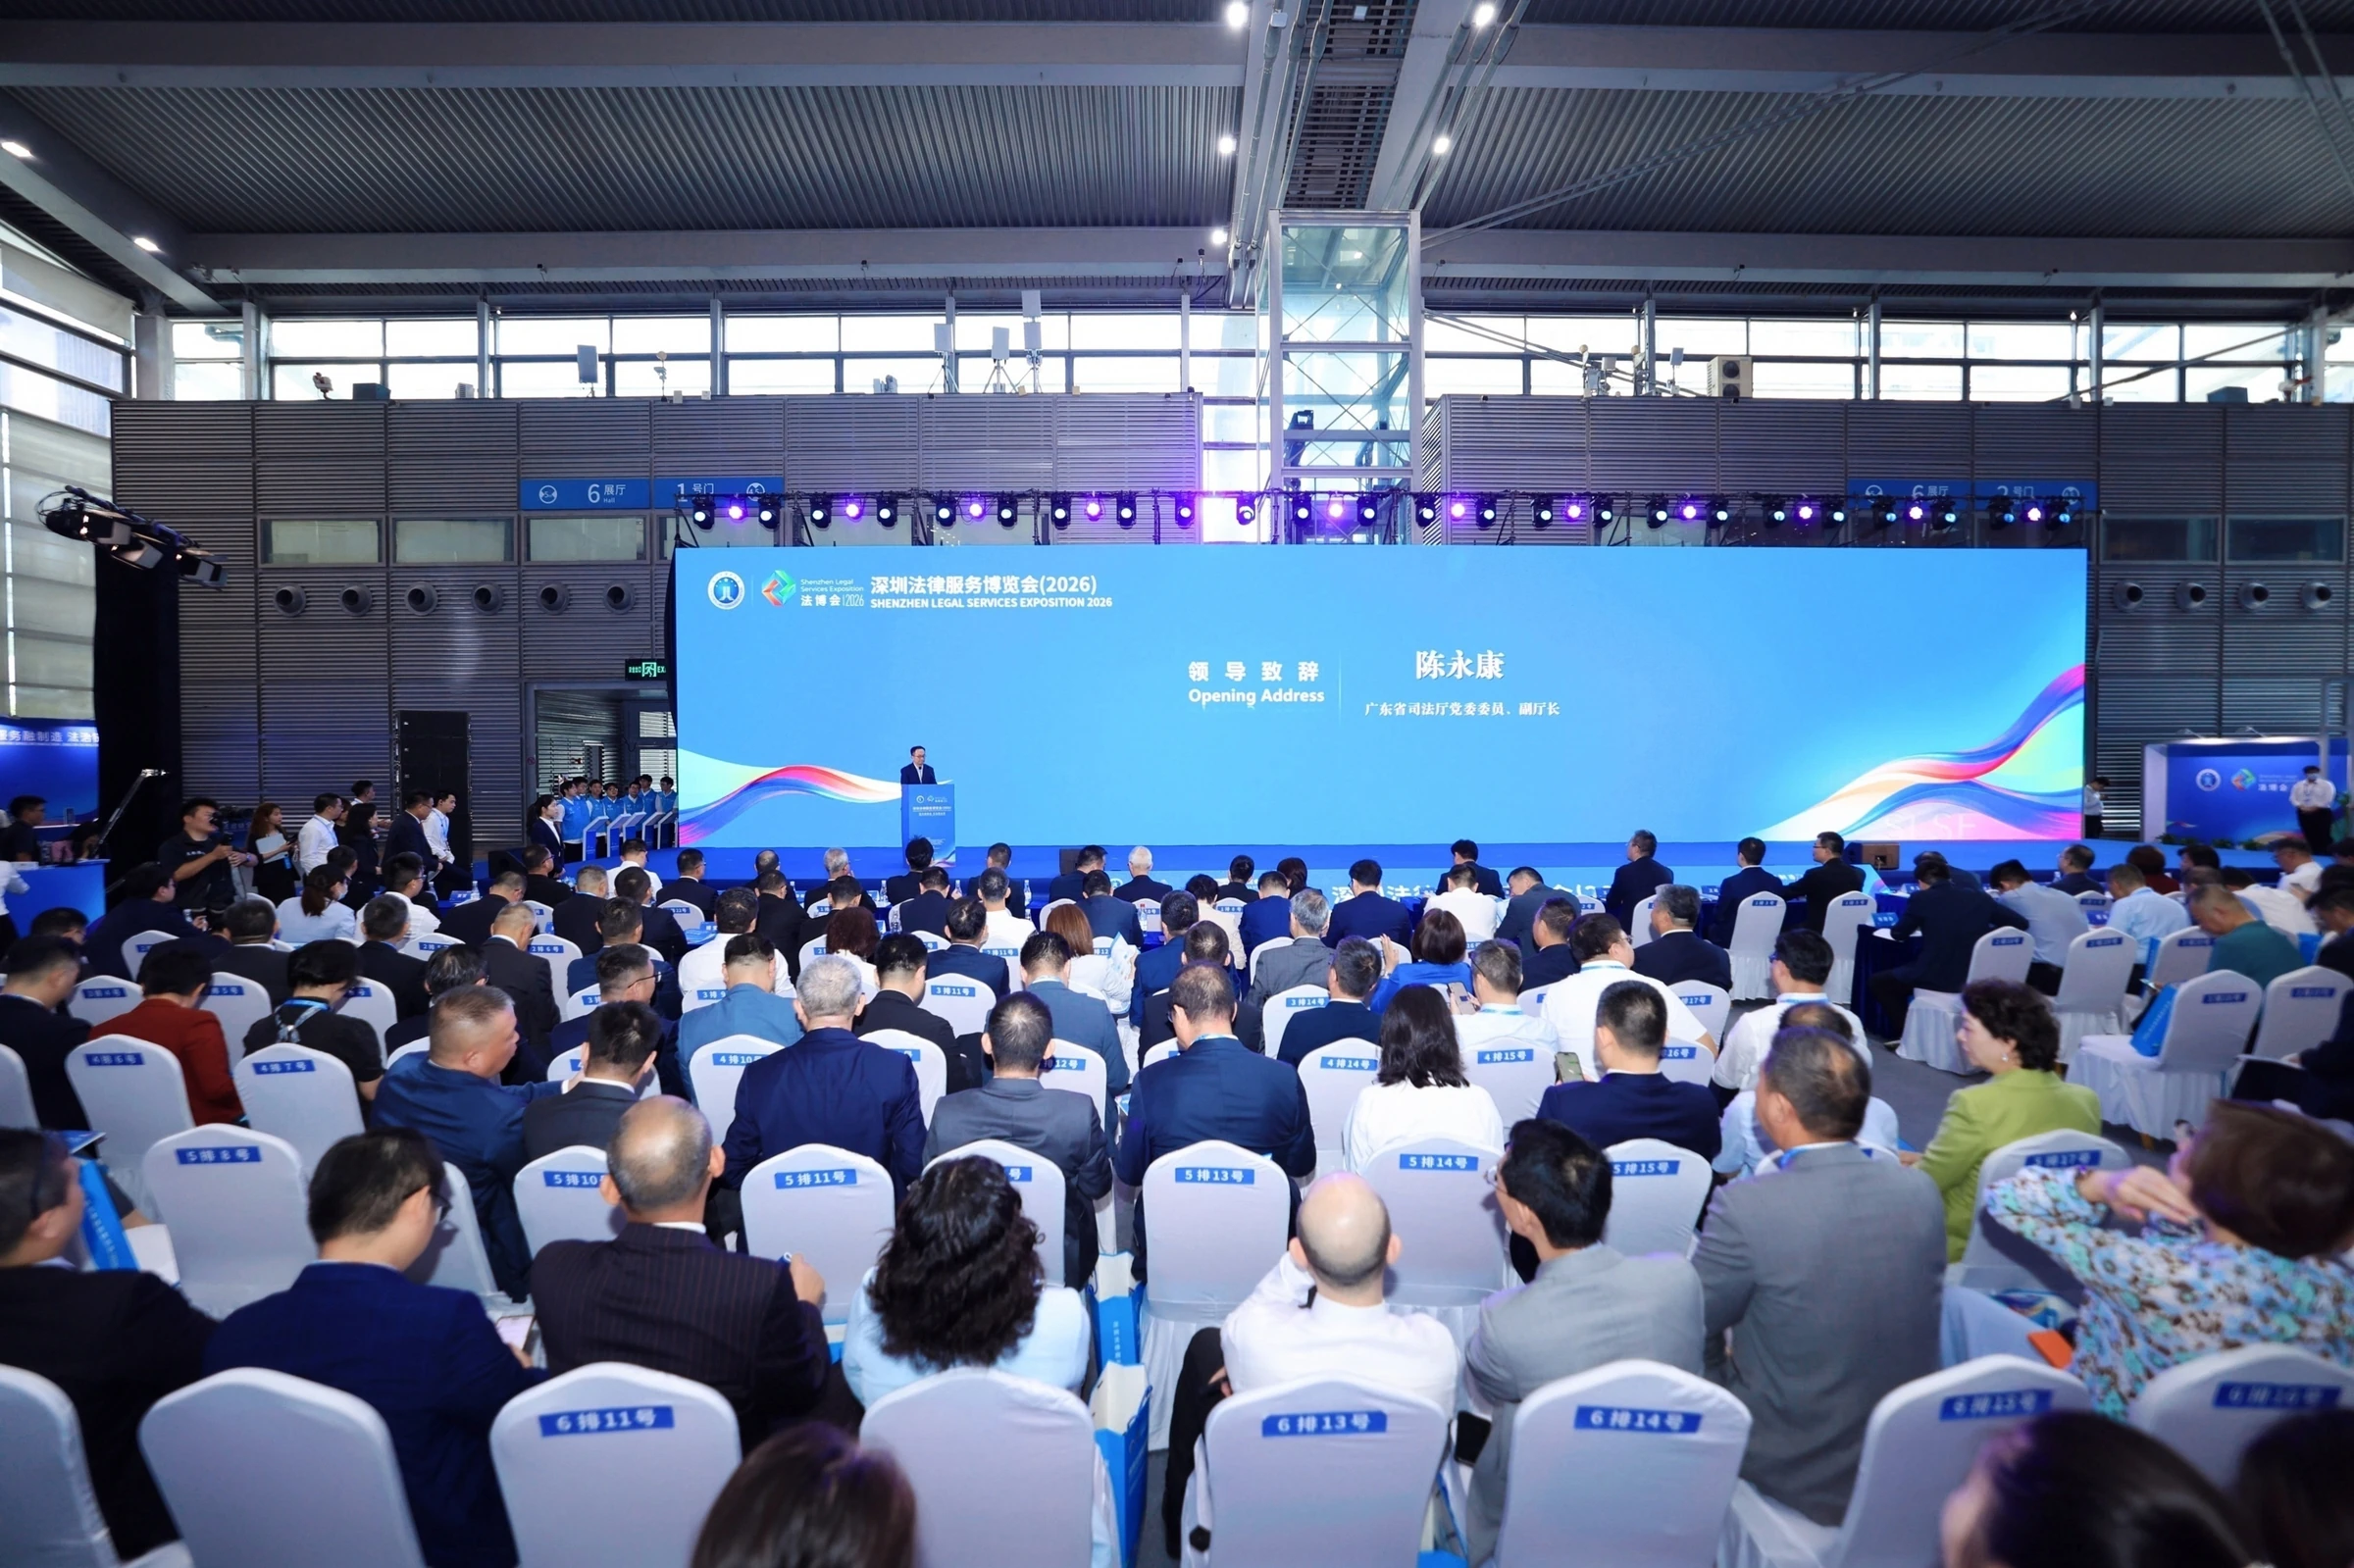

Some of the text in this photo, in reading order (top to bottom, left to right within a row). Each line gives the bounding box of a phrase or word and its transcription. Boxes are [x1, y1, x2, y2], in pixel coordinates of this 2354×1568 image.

[588, 483, 626, 503] 6 展厅
[677, 483, 715, 502] 1 号门
[871, 575, 1098, 595] 深圳法律服务博览会(2026)
[845, 594, 864, 607] 2026
[870, 597, 1112, 608] SHENZHEN LEGAL SERVICES EXPOSITION 2026
[1415, 649, 1505, 681] 陈永康
[1188, 688, 1325, 704] Opening Address
[1364, 701, 1561, 717] 广东省司法厅党委委员、副厅长
[936, 986, 970, 996] 3排11号
[1291, 996, 1326, 1007] 3排14号
[1484, 1050, 1527, 1062] 4排15号
[1326, 1059, 1371, 1071] 4排14号
[185, 1147, 251, 1163] 5排8号
[1408, 1156, 1468, 1170] 5排14号
[1612, 1160, 1669, 1175] 5排15号
[786, 1170, 845, 1187] 5排11号
[1184, 1168, 1245, 1184] 5排13号
[555, 1407, 658, 1433] 6排11号
[1277, 1413, 1370, 1433] 6排13号
[1589, 1409, 1685, 1431] 6排14号
